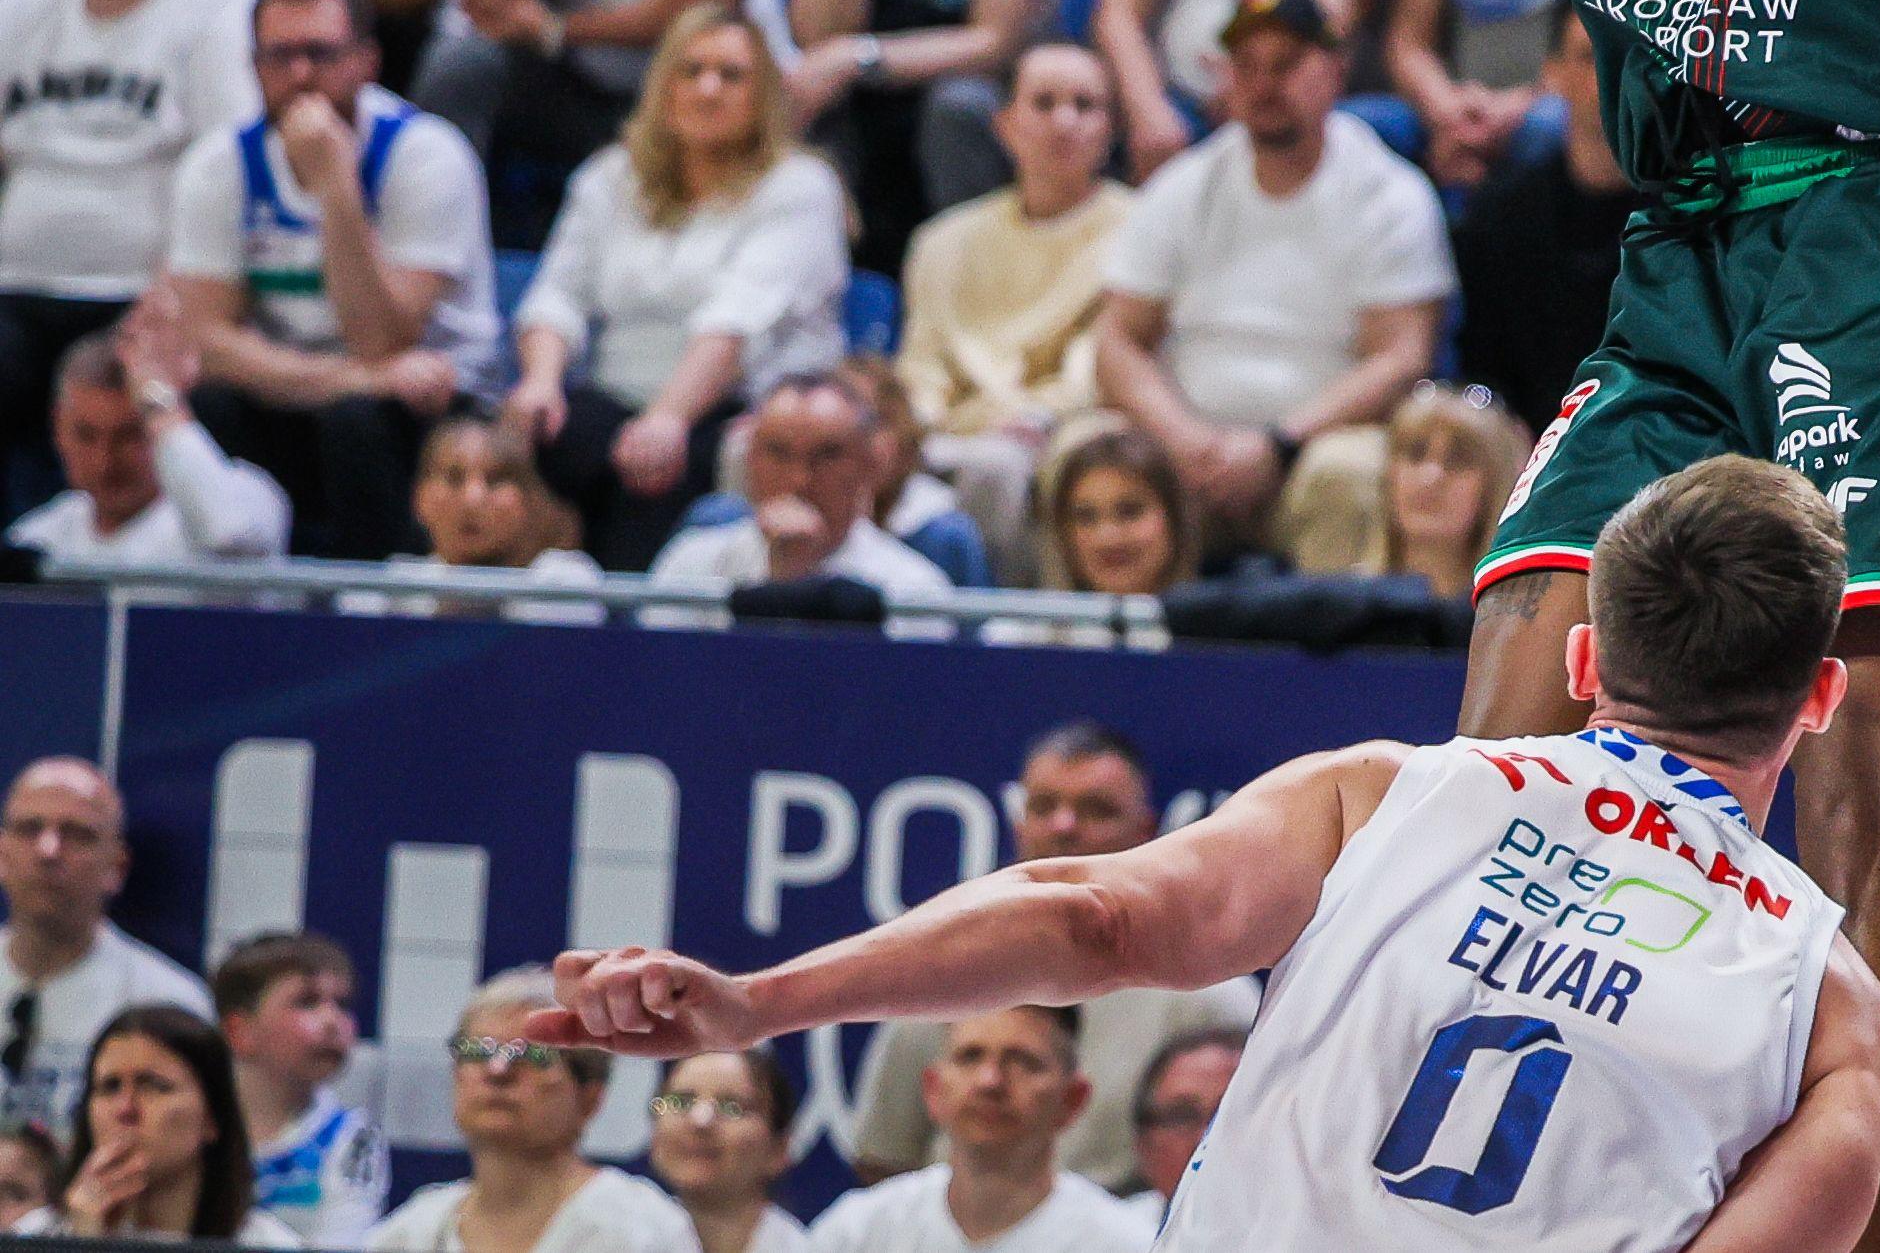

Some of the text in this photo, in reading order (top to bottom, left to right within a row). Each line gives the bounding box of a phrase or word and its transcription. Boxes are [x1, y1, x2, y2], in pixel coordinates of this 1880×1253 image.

[1638, 24, 1784, 64] PORT
[1498, 817, 1611, 892] pre
[1479, 857, 1627, 937] zero
[1447, 904, 1644, 1027] ELVAR
[1373, 1013, 1573, 1217] 0
